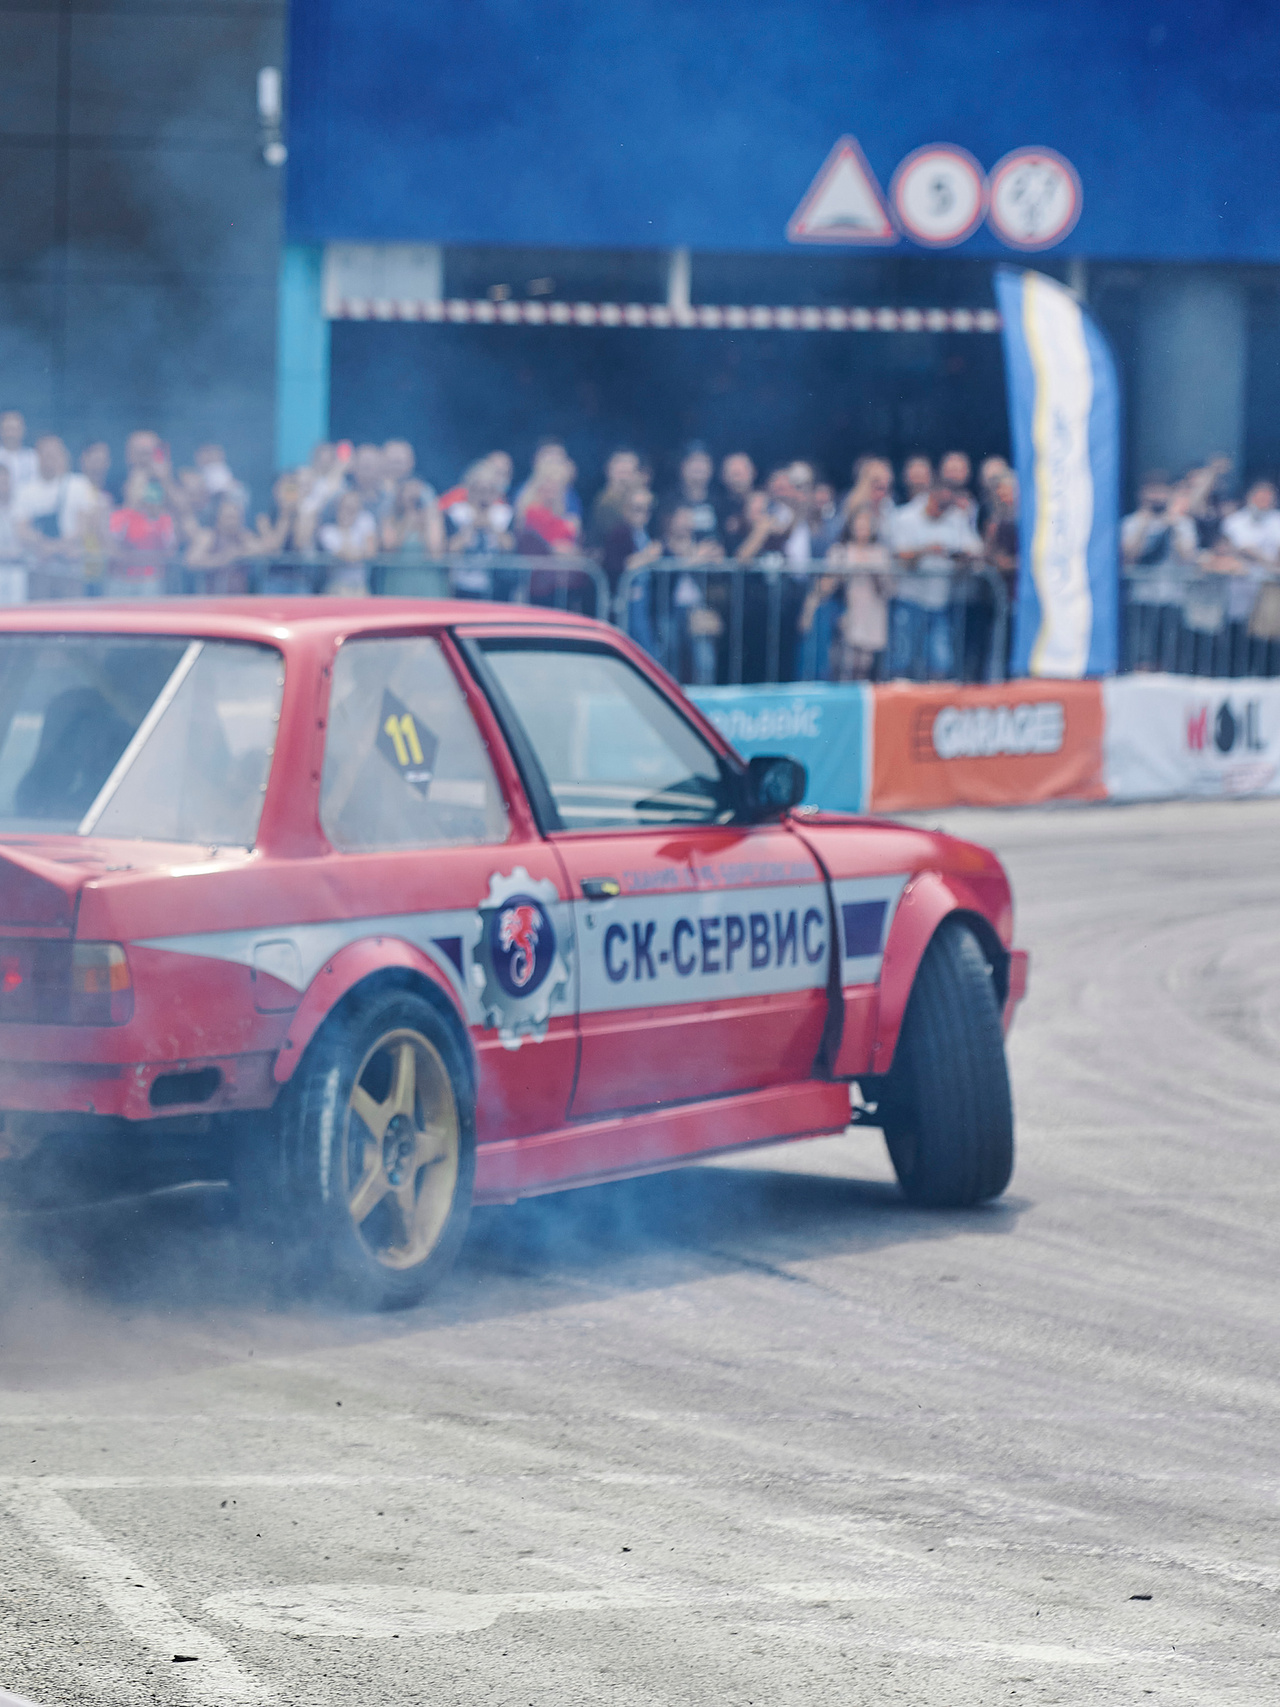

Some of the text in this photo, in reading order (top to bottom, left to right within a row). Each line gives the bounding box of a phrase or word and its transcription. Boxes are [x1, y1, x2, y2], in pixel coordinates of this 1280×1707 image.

[384, 713, 424, 766] 11
[932, 702, 1064, 759] GARAGE
[603, 906, 826, 984] СК-СЕРВИС
